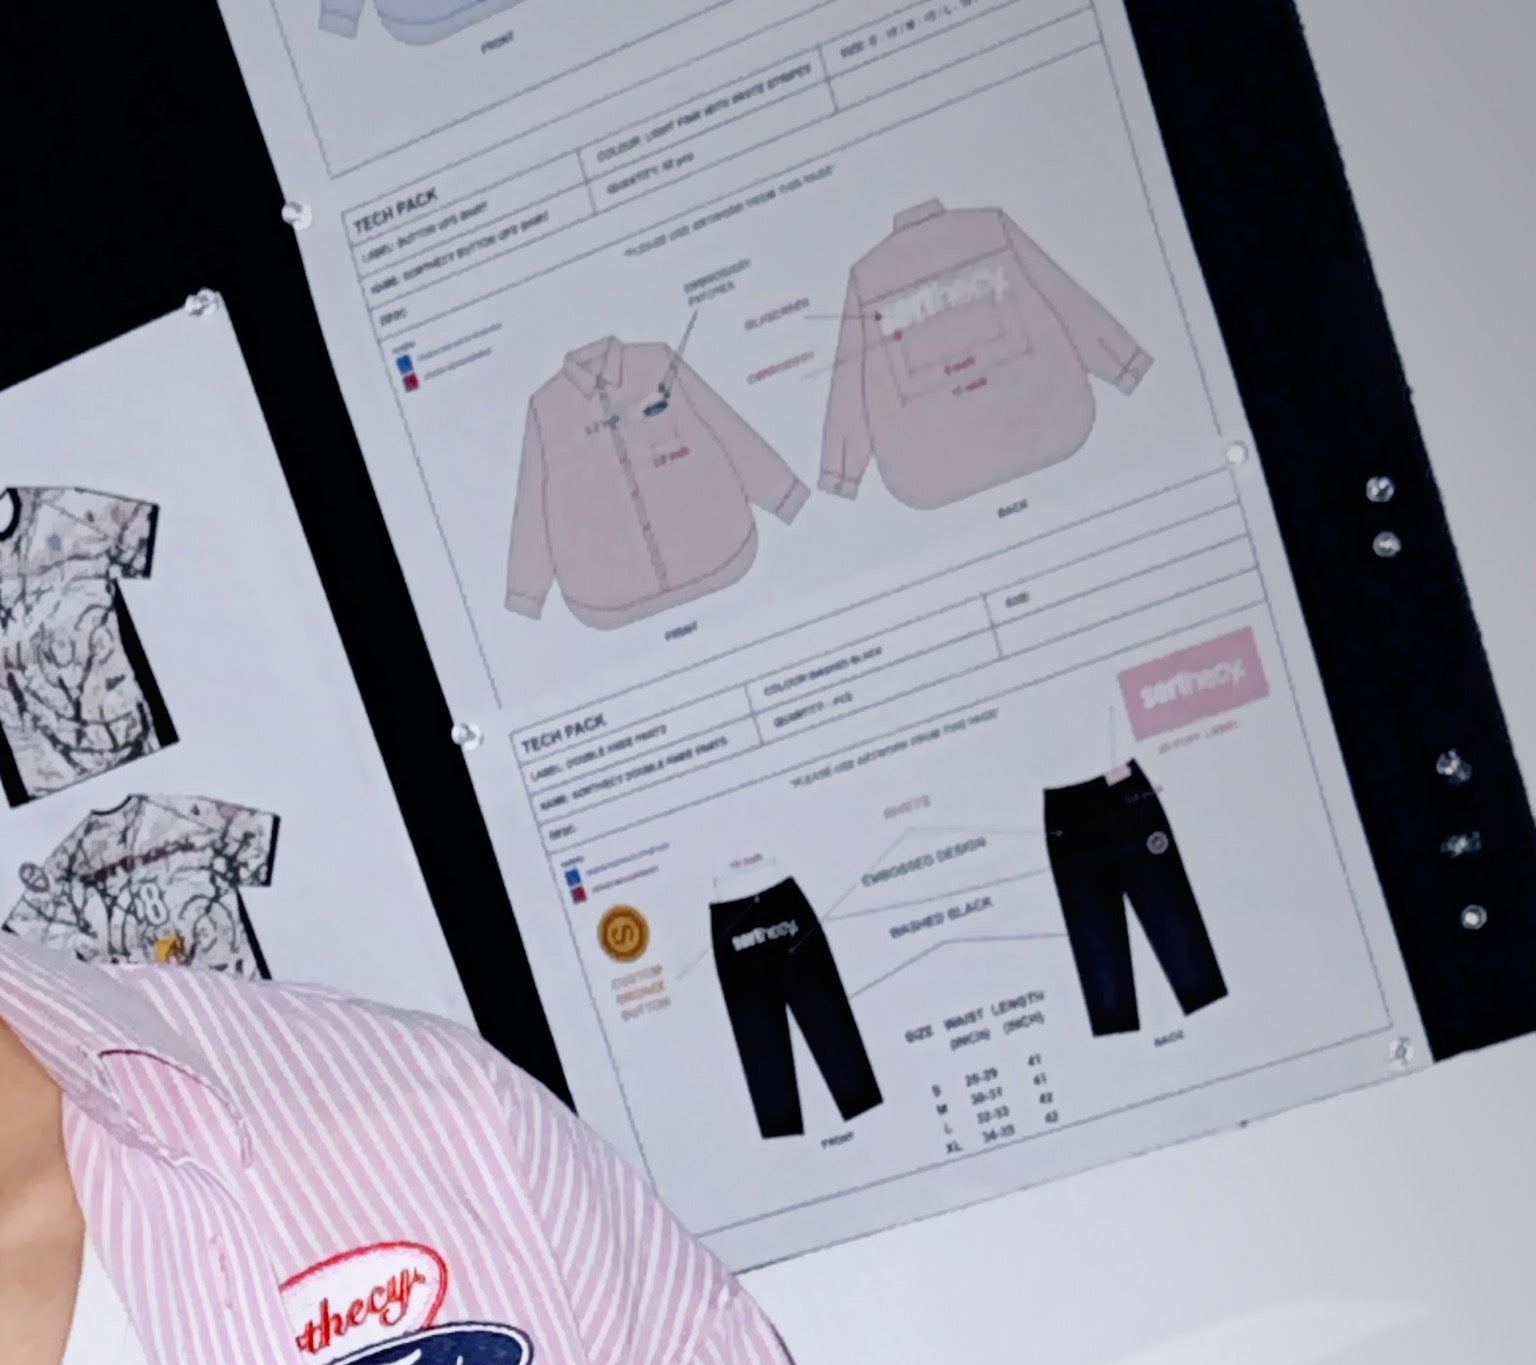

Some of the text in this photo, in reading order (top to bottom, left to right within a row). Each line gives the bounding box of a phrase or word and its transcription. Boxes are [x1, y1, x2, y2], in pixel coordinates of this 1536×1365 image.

[352, 186, 440, 234] TECH PACK
[520, 711, 607, 756] TECH PACK
[947, 897, 993, 921] BLACK
[903, 987, 1046, 1045] SIZE WAIST LENGTH
[944, 1138, 963, 1156] XL
